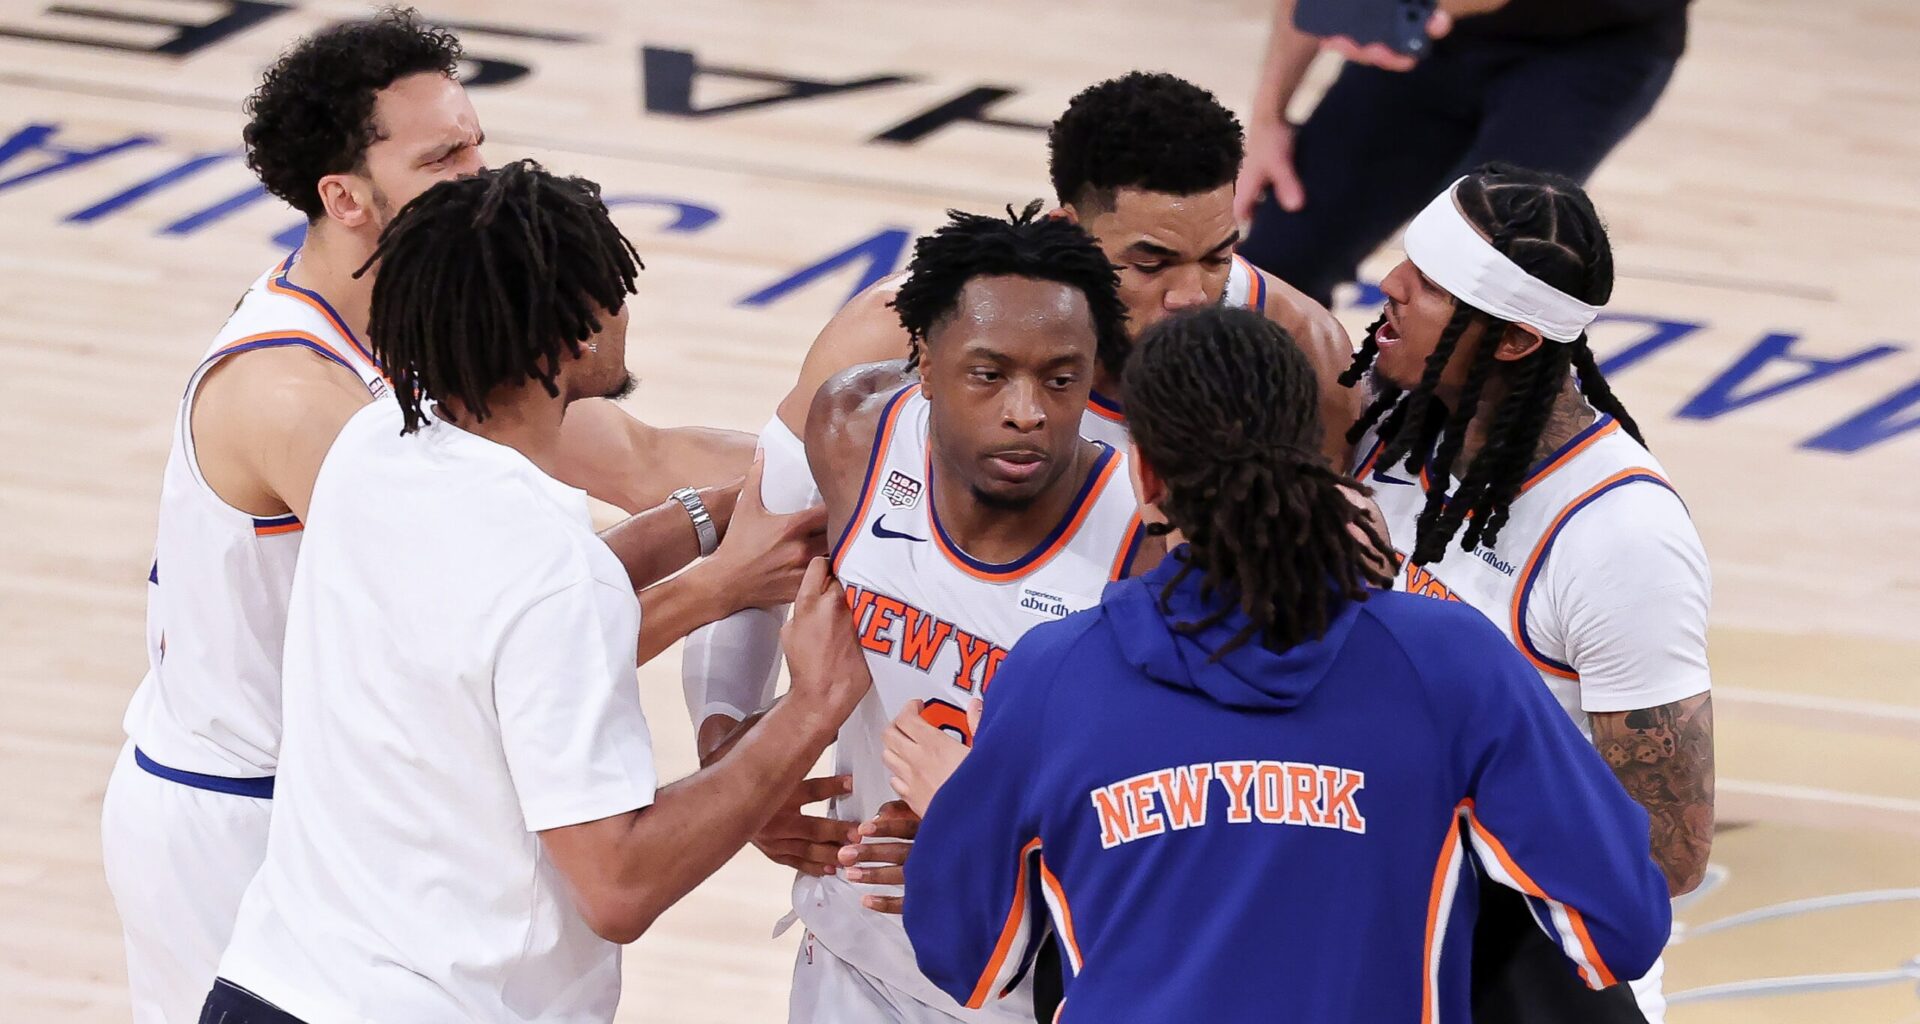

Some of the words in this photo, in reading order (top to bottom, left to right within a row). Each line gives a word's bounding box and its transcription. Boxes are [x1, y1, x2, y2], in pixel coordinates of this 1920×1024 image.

[891, 472, 919, 493] USA
[882, 485, 915, 506] 250
[1482, 549, 1516, 577] dhabi
[1020, 597, 1049, 613] abu
[1024, 589, 1063, 602] experience
[1091, 763, 1212, 849] NEW
[1214, 761, 1366, 834] YORK
